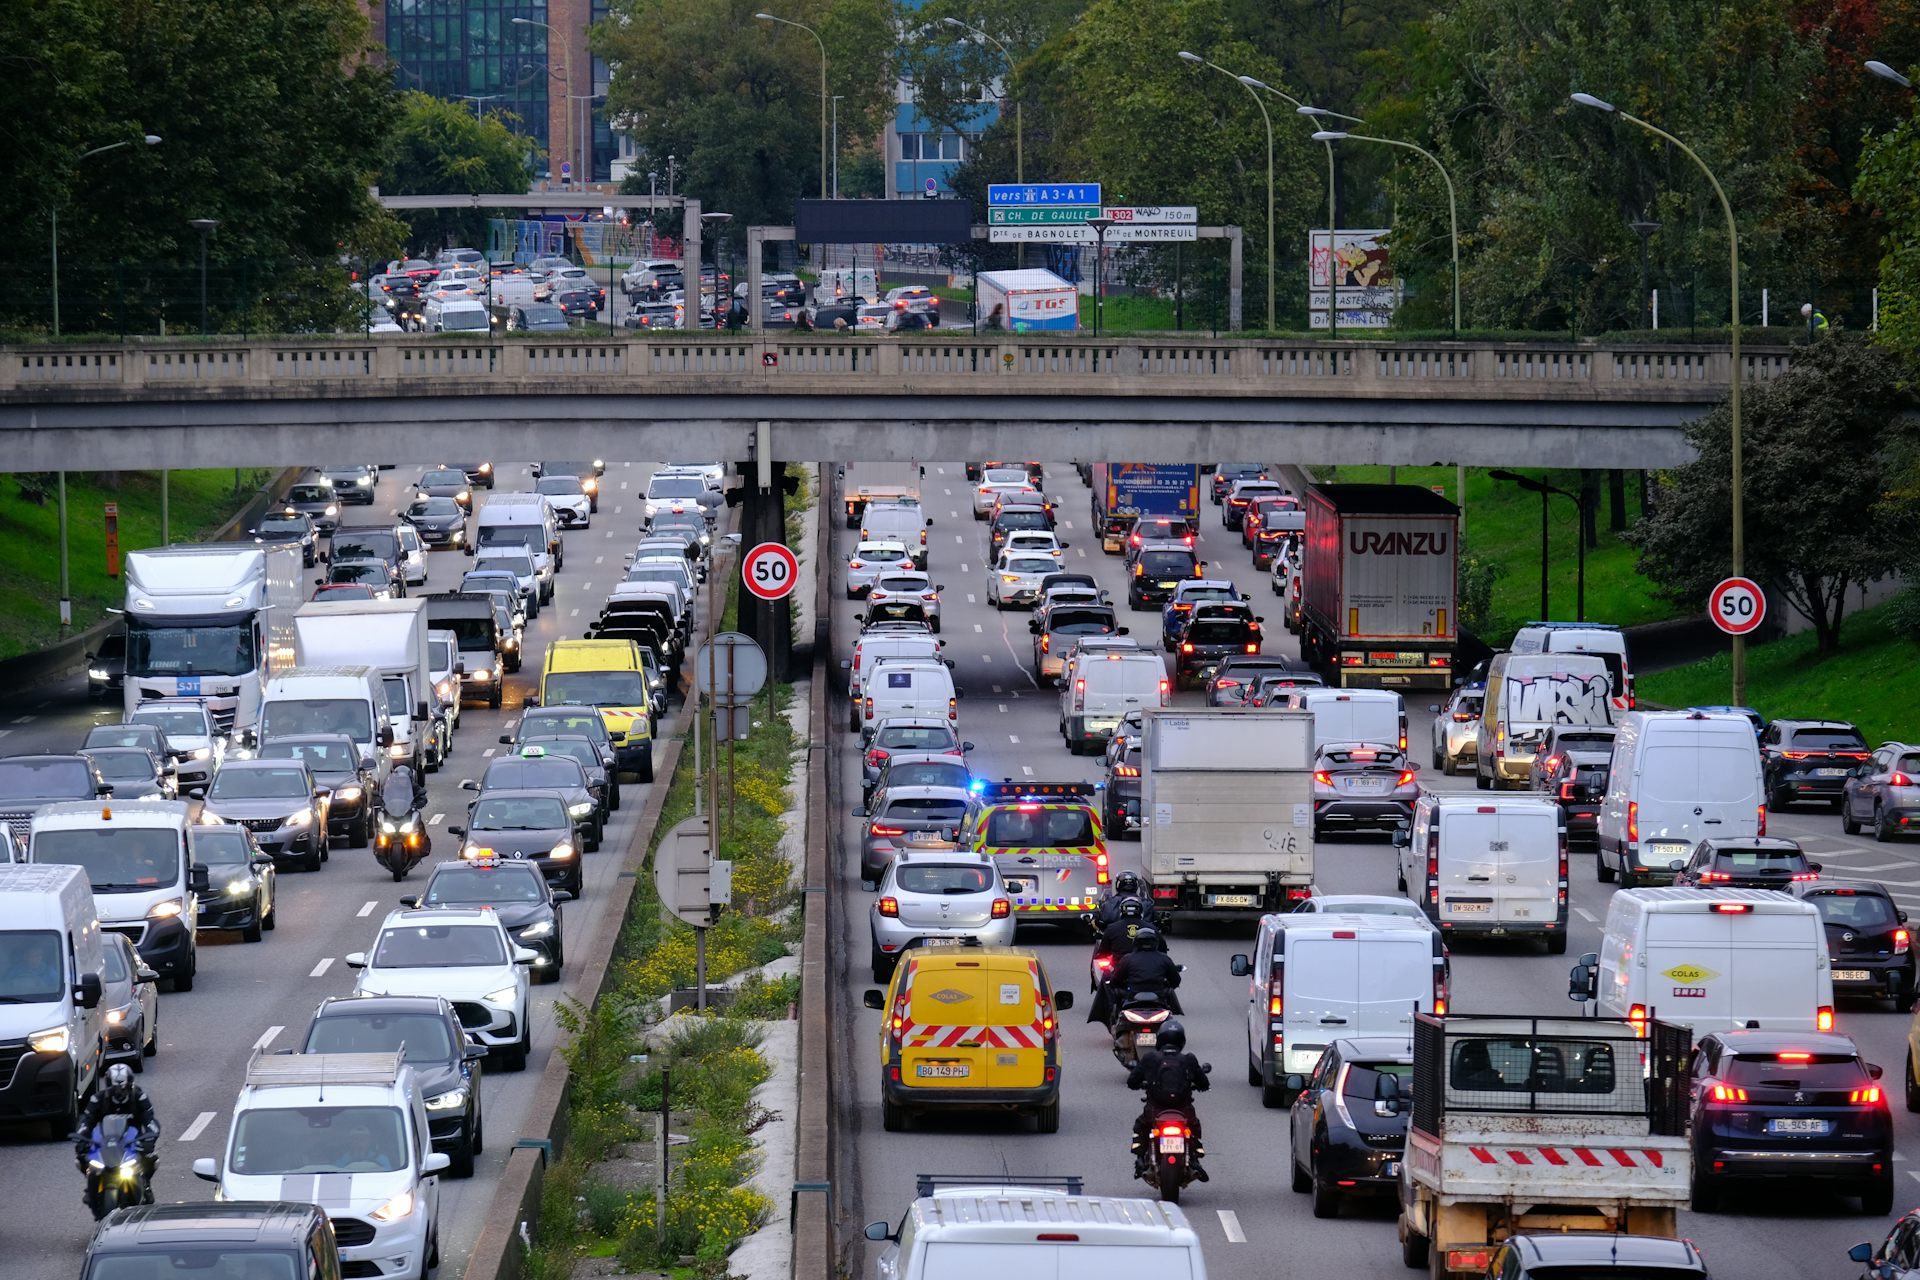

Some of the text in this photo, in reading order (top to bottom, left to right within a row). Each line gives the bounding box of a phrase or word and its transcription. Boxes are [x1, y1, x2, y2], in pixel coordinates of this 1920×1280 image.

[994, 190, 1020, 200] vers
[1008, 210, 1090, 220] CH. DE GAULLE
[1106, 210, 1132, 219] N302
[1028, 229, 1086, 238] BAGNOLET
[1135, 229, 1193, 237] MONTREUIL
[1314, 316, 1361, 324] Dirction
[1350, 531, 1446, 555] URANZU
[755, 560, 786, 581] 50
[1722, 596, 1753, 616] 50
[179, 682, 201, 691] SJT
[1777, 1121, 1820, 1130] GL-949-AF
